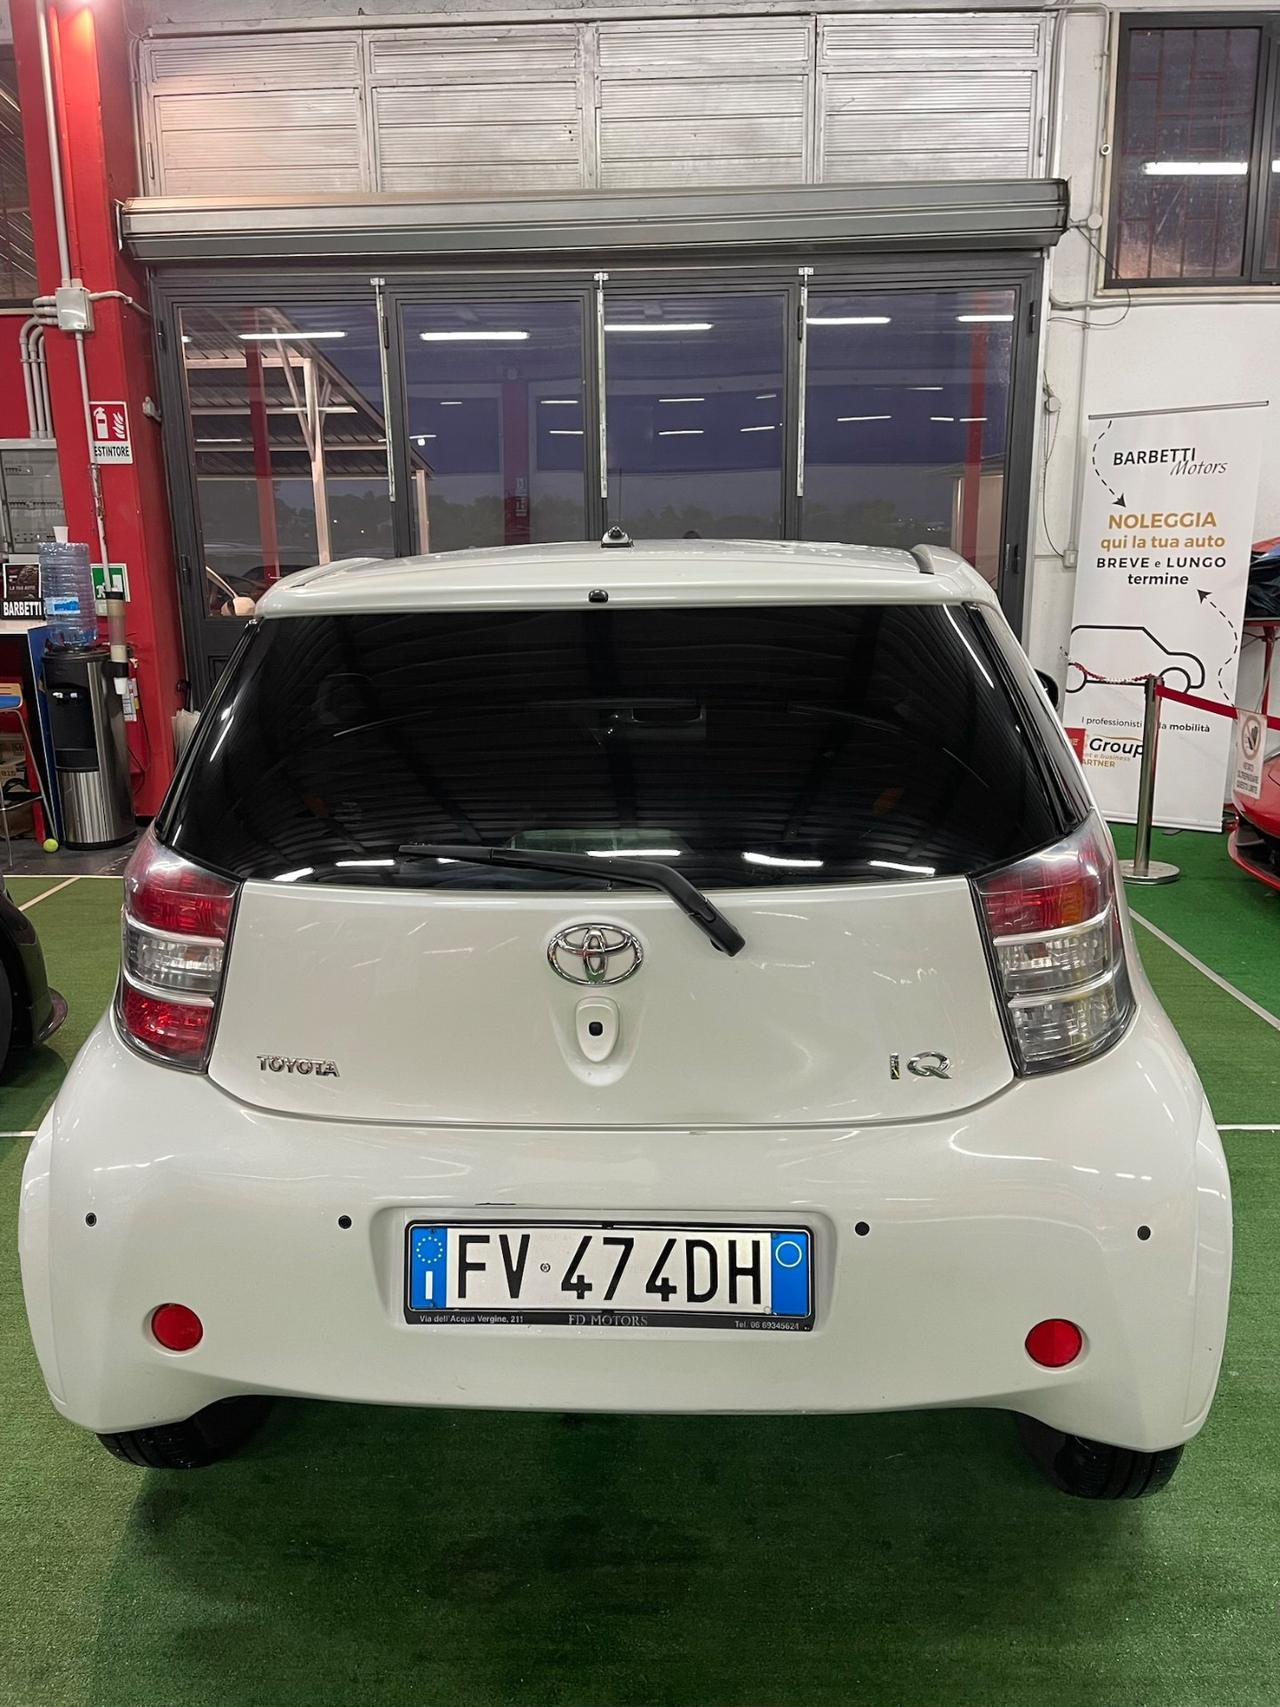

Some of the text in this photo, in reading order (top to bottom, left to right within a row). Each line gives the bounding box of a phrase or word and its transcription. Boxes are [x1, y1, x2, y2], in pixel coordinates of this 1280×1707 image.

[94, 446, 130, 457] ESTINTORE
[1113, 448, 1196, 466] BARBETTI
[1170, 459, 1229, 476] Motors
[1108, 511, 1217, 529] NOLEGGIA
[1100, 535, 1226, 552] qui la tua auto
[1096, 557, 1227, 568] BREVE e LUNGO
[1128, 571, 1189, 585] termine
[3, 601, 42, 616] BARBETTI
[1086, 716, 1143, 729] professionisti
[1169, 722, 1211, 733] mobilità
[1089, 738, 1144, 758] Group
[1083, 758, 1116, 768] ARTNER
[256, 1055, 340, 1077] TOYOTA
[457, 1234, 531, 1299] FV
[420, 1314, 523, 1324] Via dell'Acqua Vergine, 211
[568, 1314, 648, 1326] FD MOTORS
[750, 1320, 760, 1328] 06
